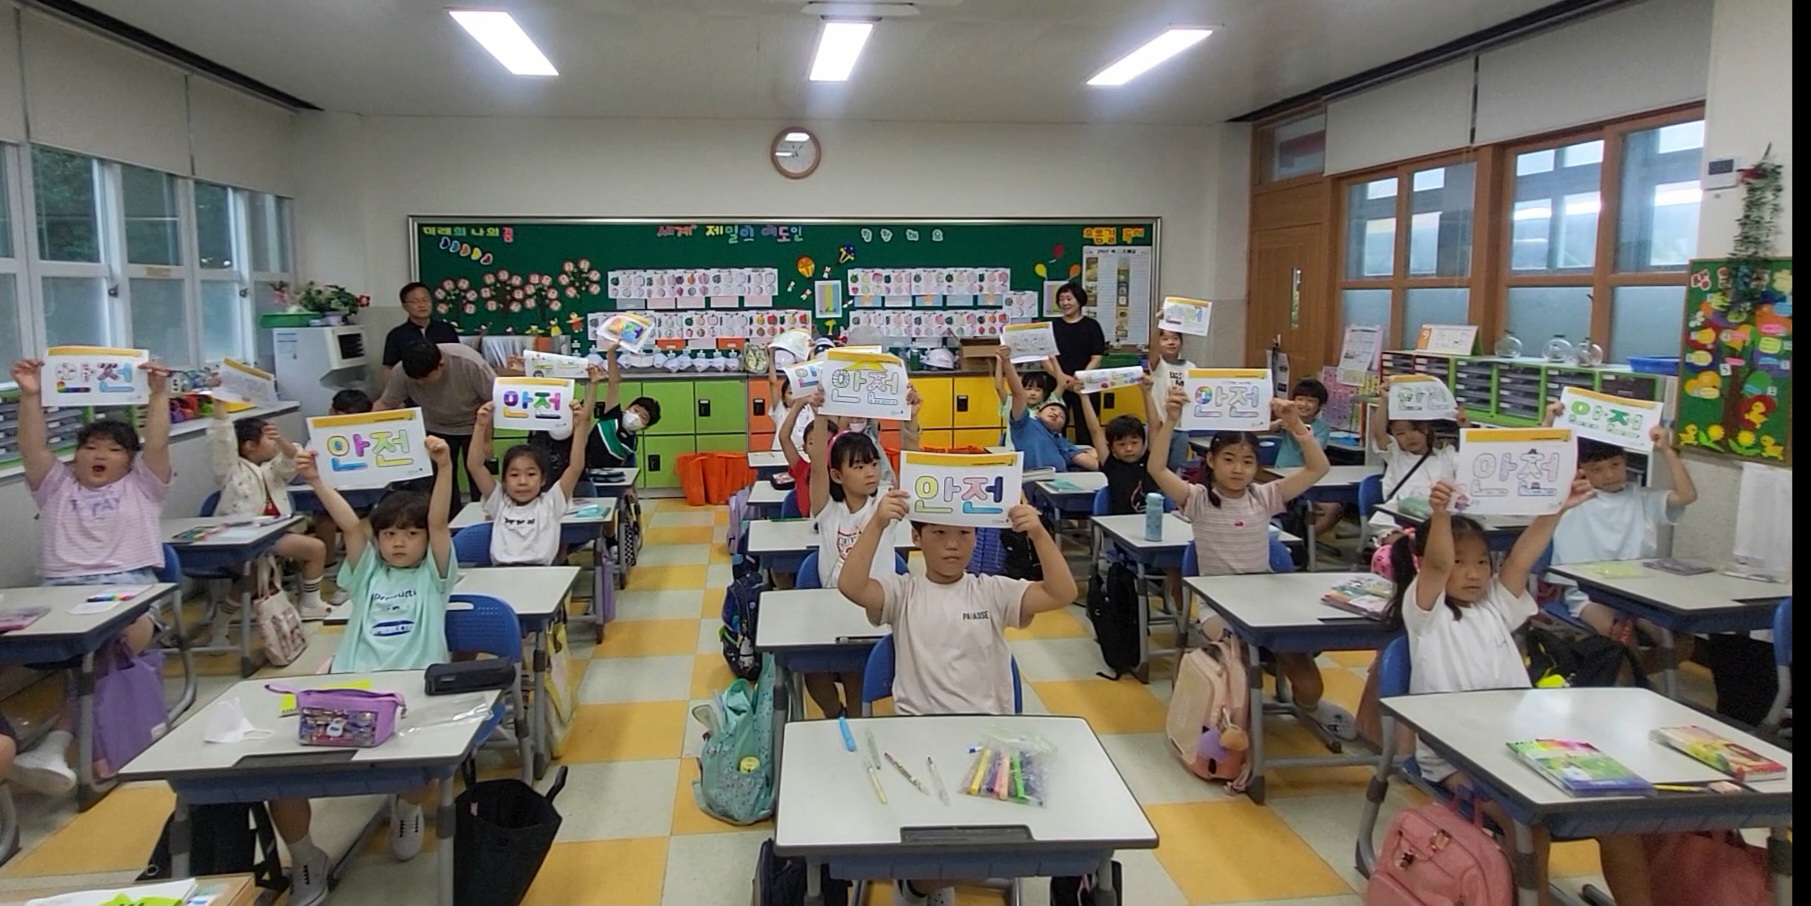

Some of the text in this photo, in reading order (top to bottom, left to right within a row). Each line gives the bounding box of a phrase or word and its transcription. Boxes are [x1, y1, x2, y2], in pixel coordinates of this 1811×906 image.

[471, 227, 499, 237] 나의
[55, 362, 134, 393] 안전
[831, 368, 899, 405] 안전
[503, 390, 562, 420] 안전
[1194, 385, 1259, 418] 안전
[1568, 401, 1643, 438] 안전
[326, 429, 414, 472] 안전
[915, 475, 1003, 514] 안전
